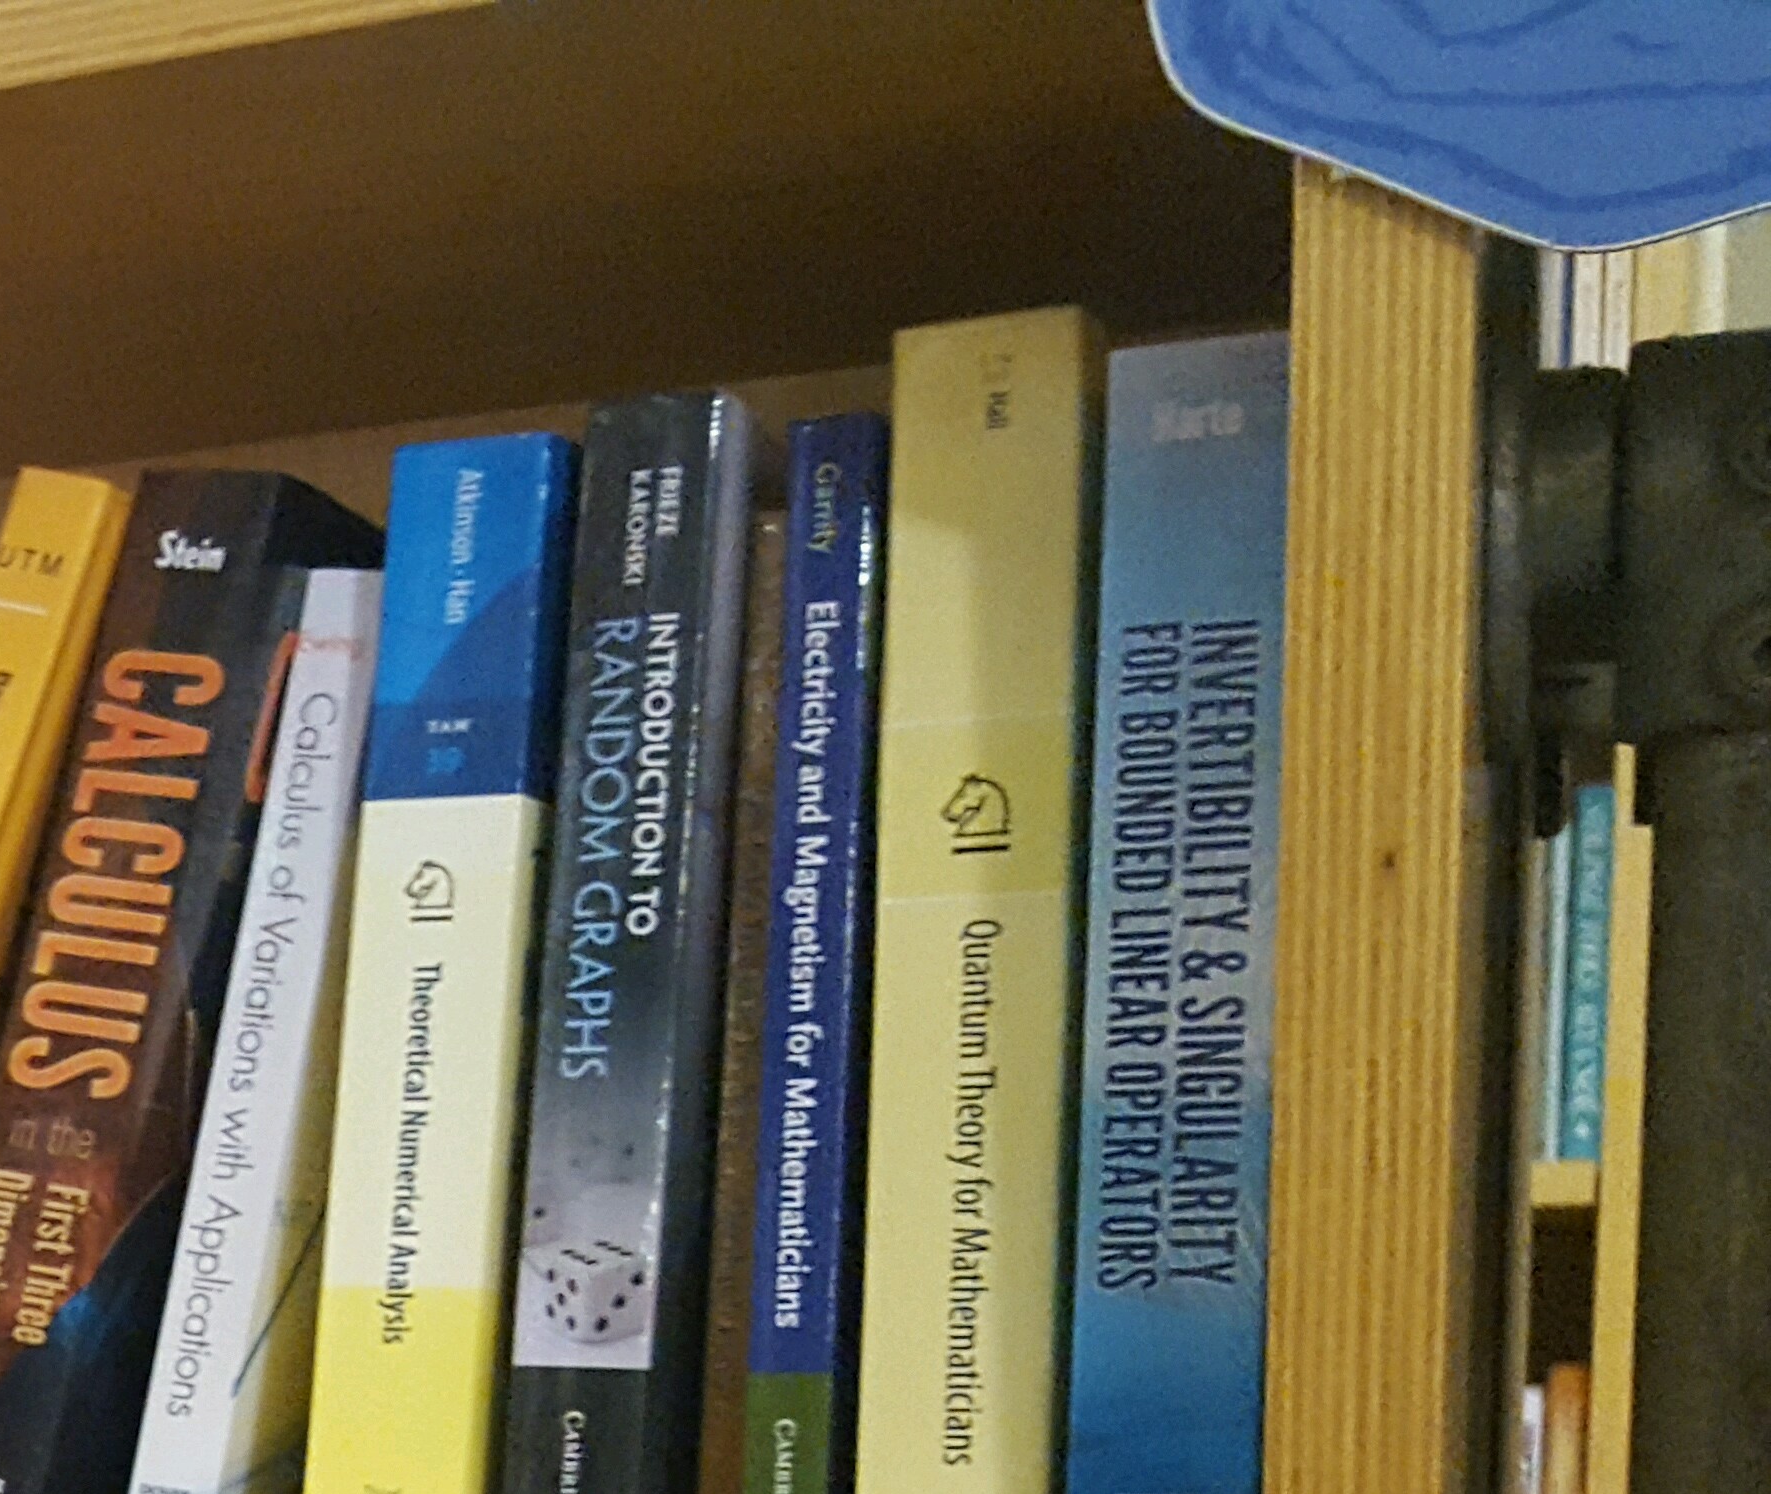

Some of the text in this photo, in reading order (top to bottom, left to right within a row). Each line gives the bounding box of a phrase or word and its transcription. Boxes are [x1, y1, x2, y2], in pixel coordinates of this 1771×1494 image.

[154, 528, 228, 573] Stein
[449, 468, 485, 563] Atkinson
[6, 648, 227, 1101] CALCULUS
[561, 617, 640, 1080] RANDOM GRAPHS
[624, 611, 680, 936] INTRODUCTION TO
[774, 600, 842, 1331] Electricity and Magnetism for Mathematicians
[1096, 619, 1183, 1293] FOR BOUNDED LINEAR OPERATORS
[1169, 618, 1261, 1287] INVERTIBILITY & SINGULARITY
[11, 1180, 91, 1348] First Three
[167, 690, 340, 1418] Calculus of Variations with Applications
[380, 961, 444, 1345] Theoretical Numerical Analysis
[942, 917, 1002, 1468] Quantum Theory for Mathematicians
